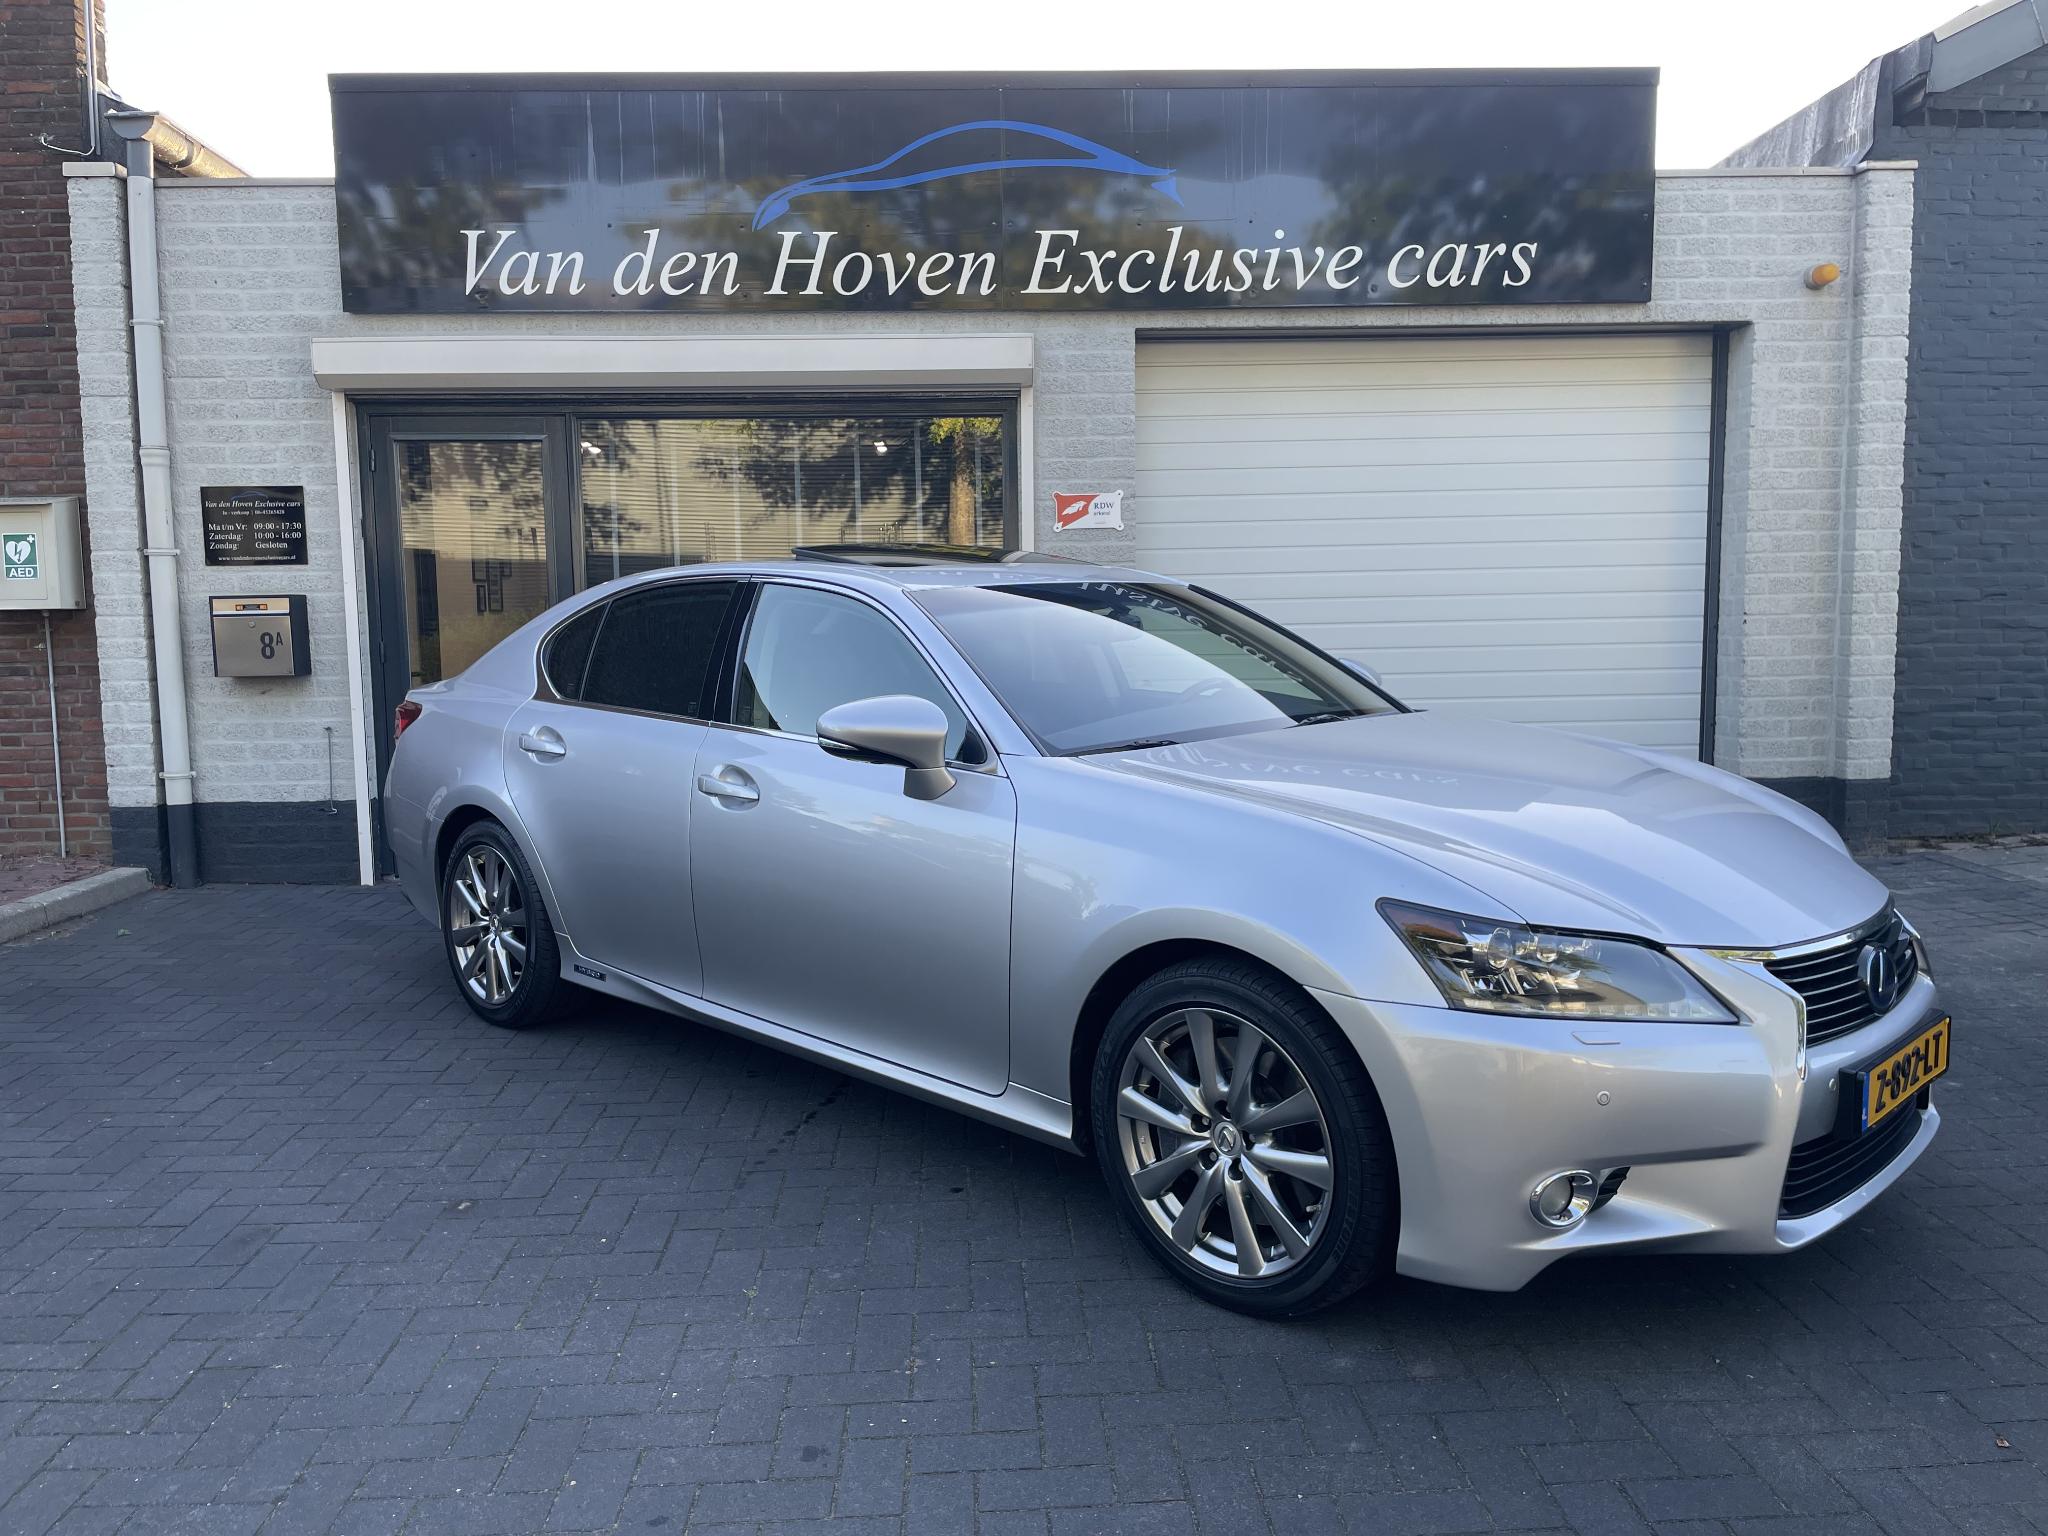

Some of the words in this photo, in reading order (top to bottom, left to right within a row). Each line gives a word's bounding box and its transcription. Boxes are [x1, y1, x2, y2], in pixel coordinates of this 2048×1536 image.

[459, 229, 586, 296] Van
[612, 228, 743, 296] den
[764, 231, 997, 296] Hoven
[1021, 226, 1366, 294] Exclusive
[1387, 240, 1538, 289] cars
[1094, 502, 1114, 510] RDW
[208, 523, 221, 531] Ma
[221, 523, 235, 531] t/m
[235, 522, 248, 531] Vr:
[253, 522, 275, 530] 09:00
[281, 522, 302, 530] 17:30
[209, 532, 244, 541] Zaterdag:
[281, 531, 302, 539] 16:00
[209, 541, 240, 550] Zondag:
[255, 541, 288, 549] Gesloten
[9, 567, 34, 578] AED
[1875, 1030, 1943, 1114] Z-892-LT
